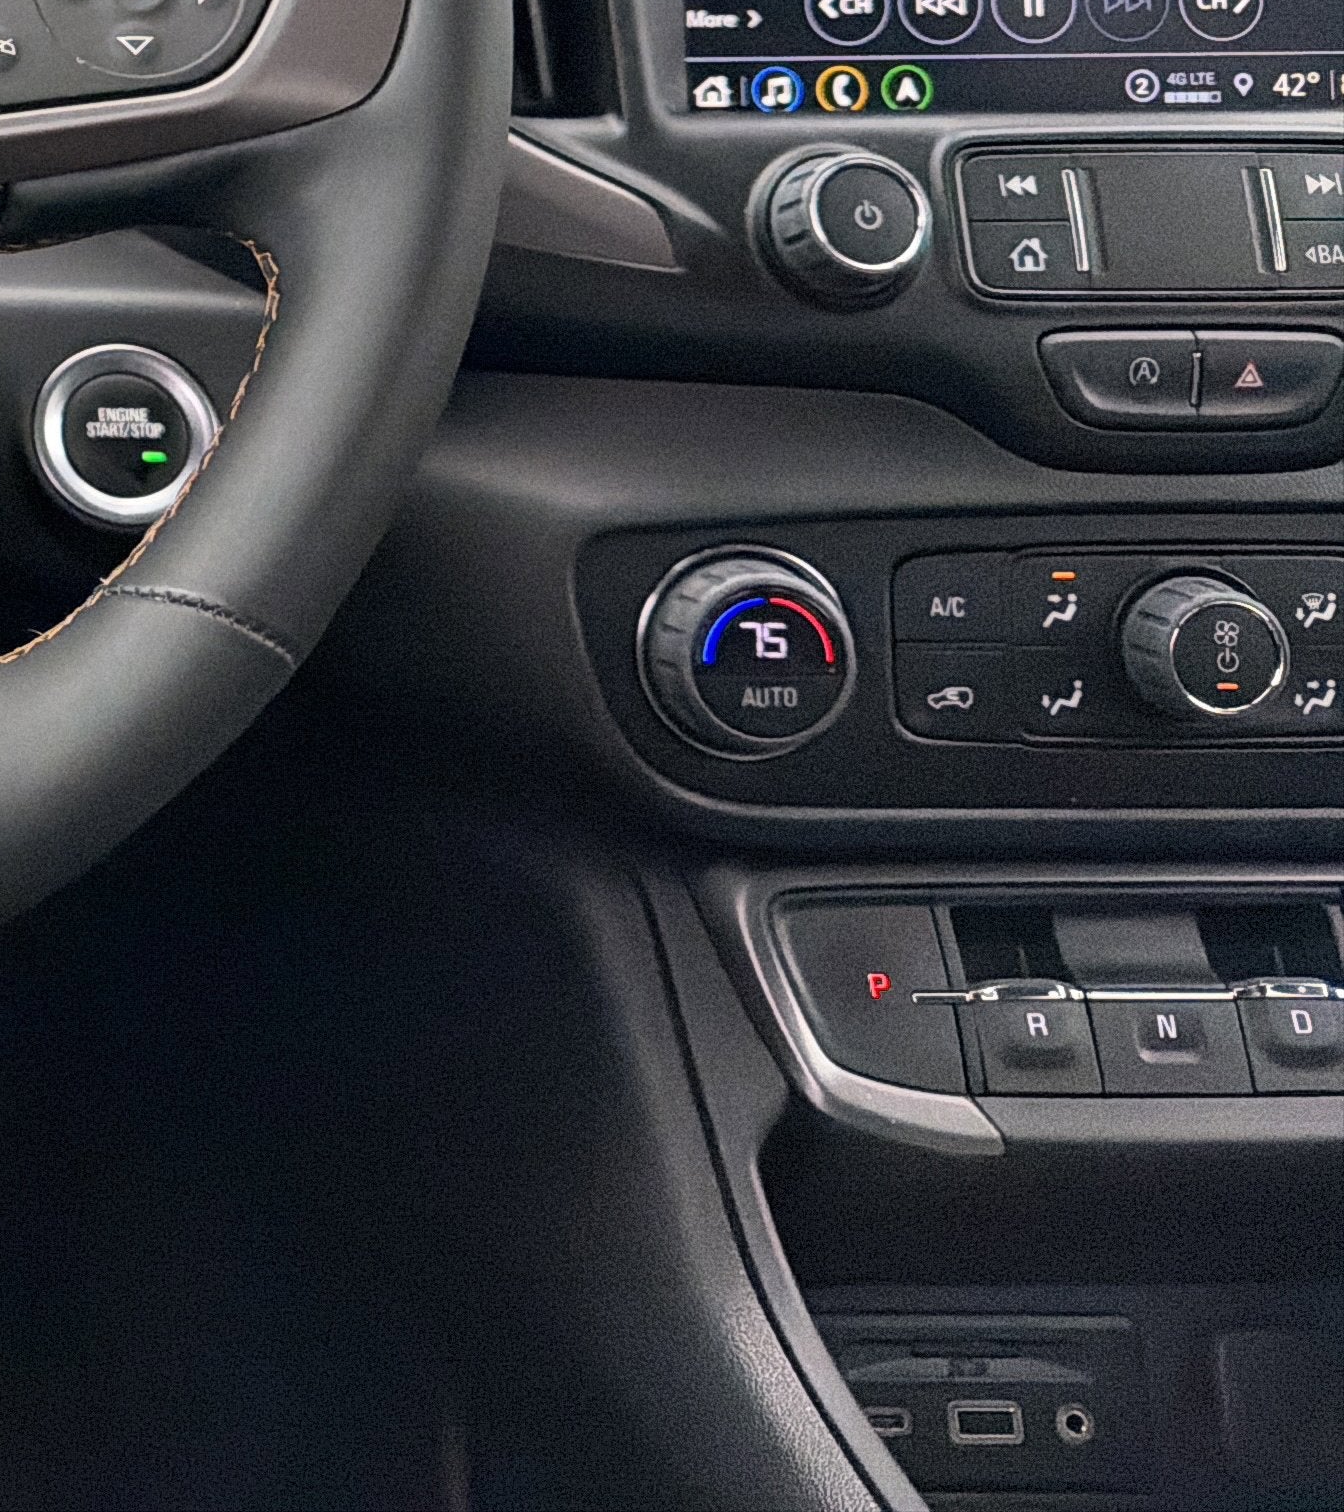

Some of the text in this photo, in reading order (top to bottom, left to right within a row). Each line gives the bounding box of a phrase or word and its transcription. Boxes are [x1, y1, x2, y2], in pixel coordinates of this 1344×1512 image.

[685, 9, 739, 29] More
[1134, 76, 1150, 96] 2
[1166, 72, 1216, 86] 4G LTE
[97, 407, 148, 422] ENGINE
[85, 421, 166, 439] START/STOP
[929, 596, 966, 618] A/C
[741, 622, 788, 660] 75
[741, 687, 798, 709] AUTO
[868, 972, 892, 1000] P
[1026, 1013, 1050, 1037] R
[1156, 1015, 1177, 1040] N
[1291, 1010, 1313, 1036] D
